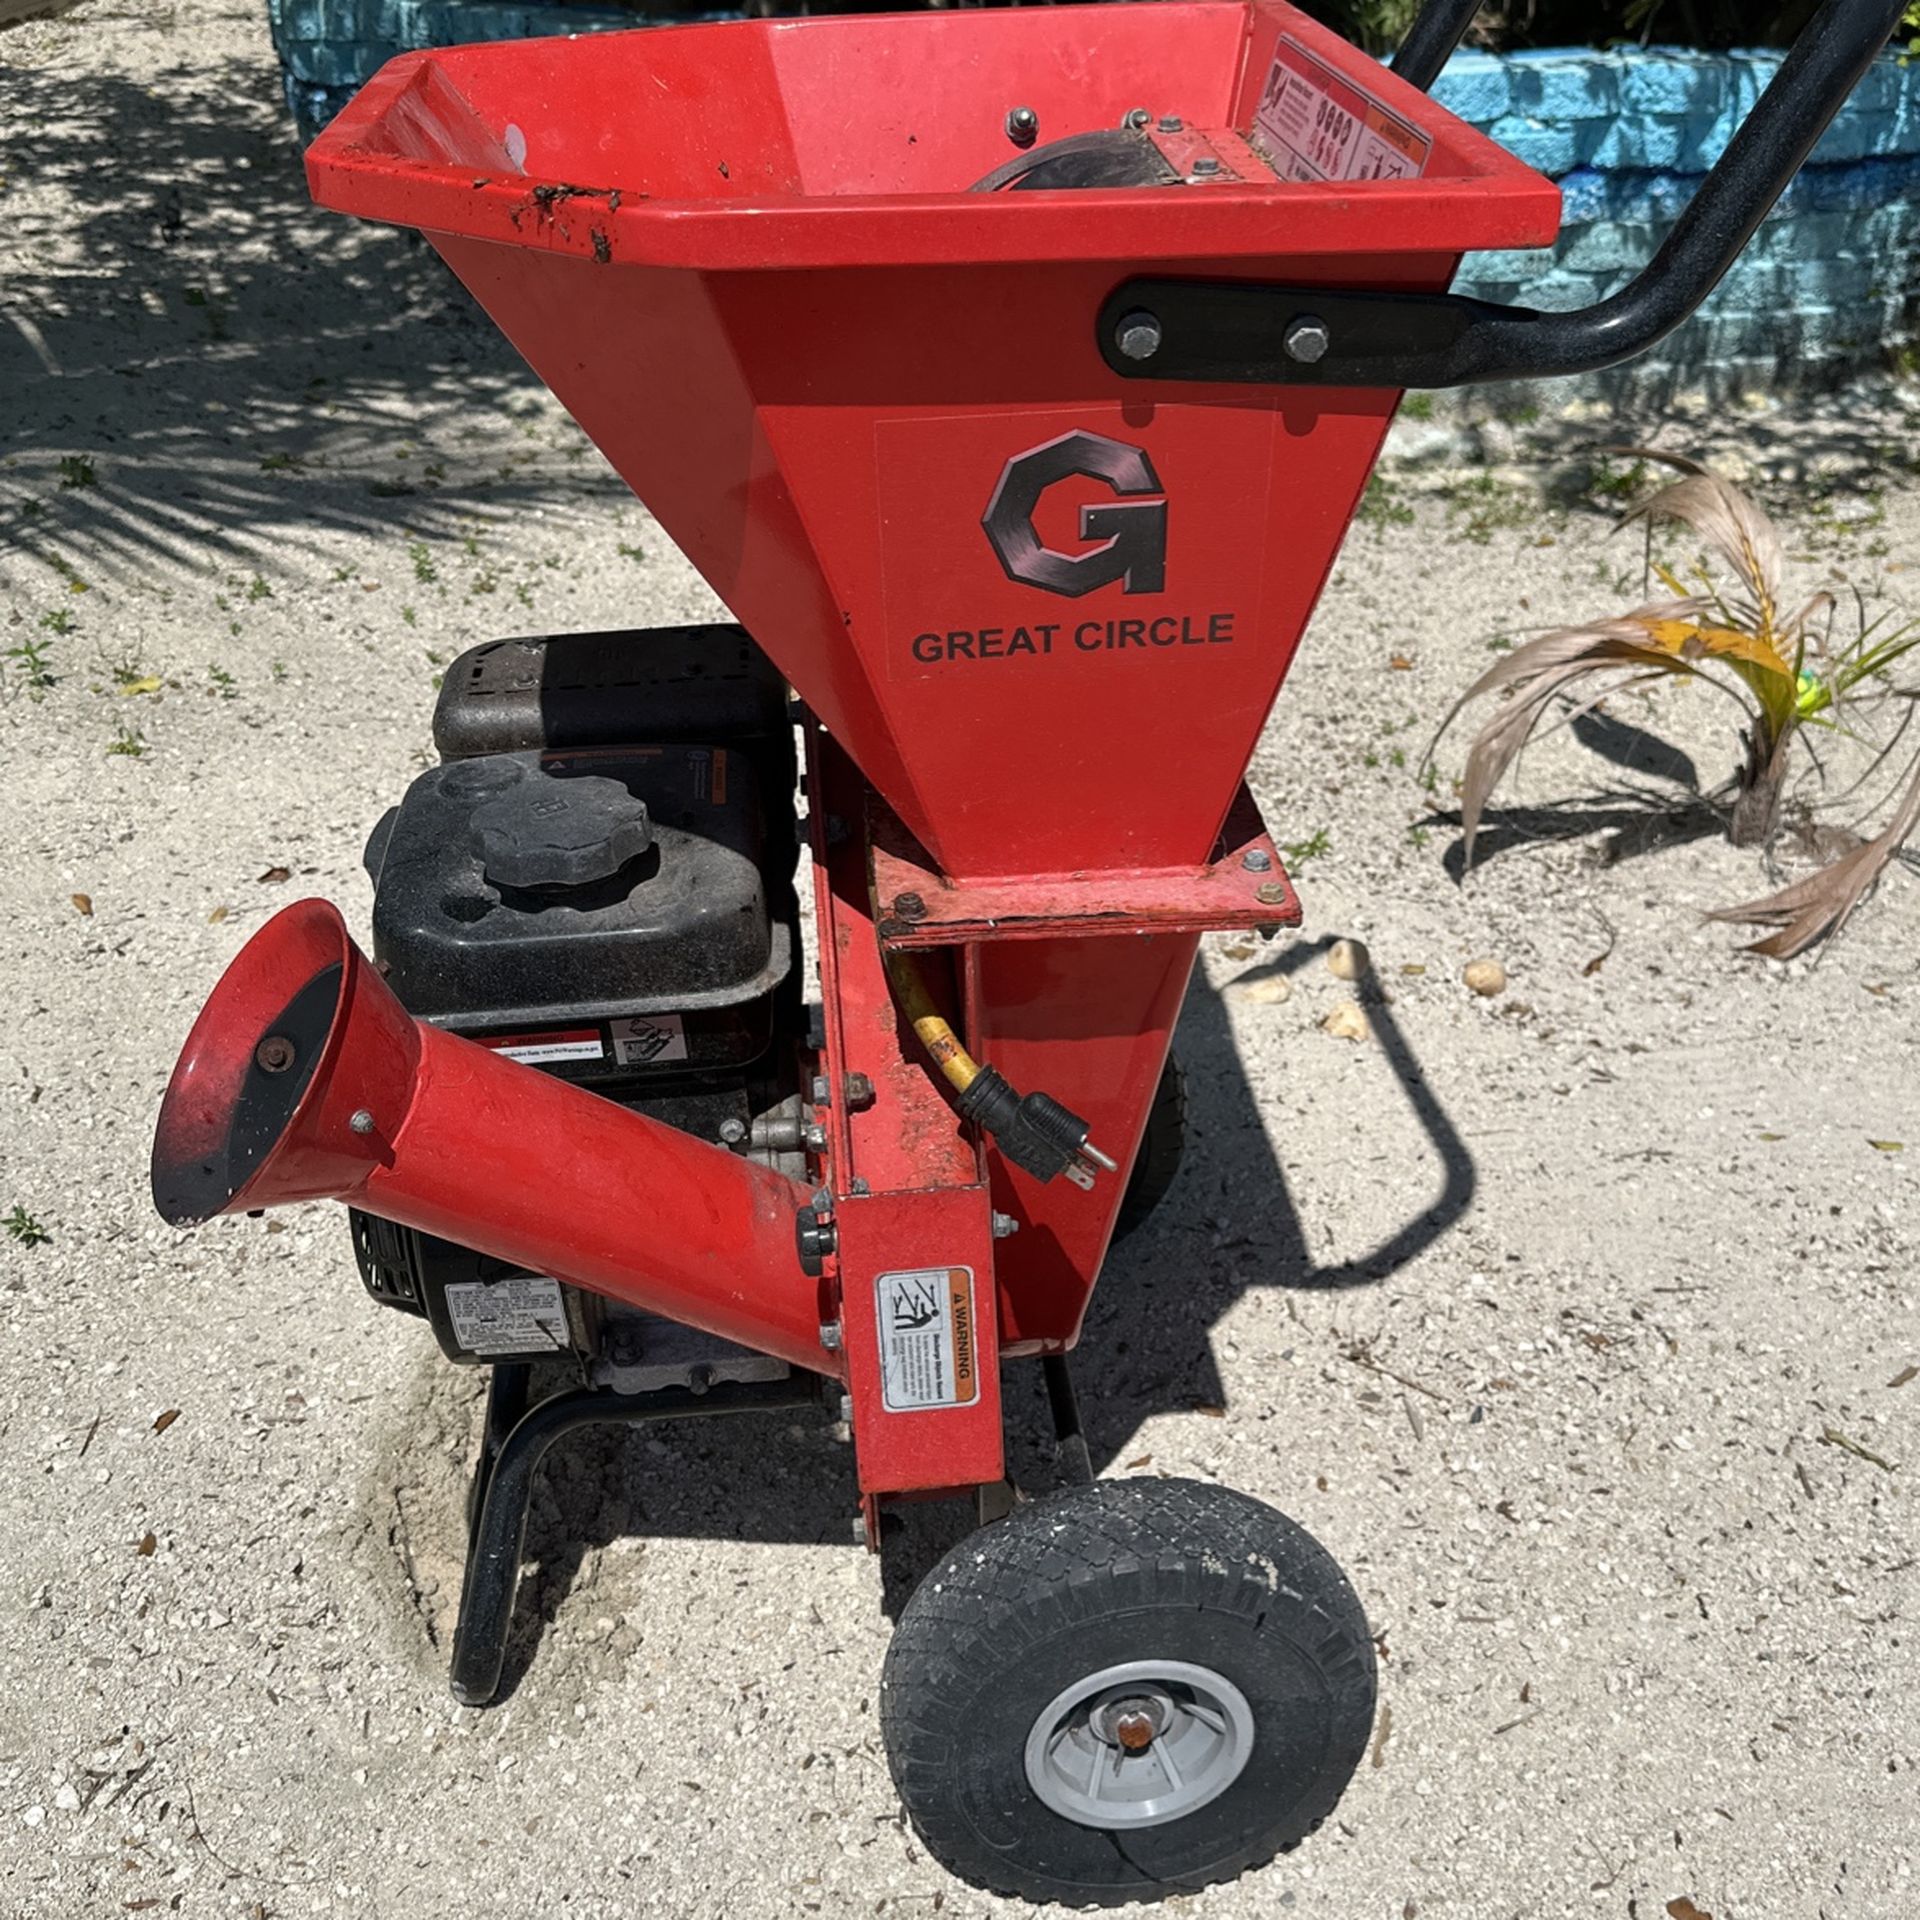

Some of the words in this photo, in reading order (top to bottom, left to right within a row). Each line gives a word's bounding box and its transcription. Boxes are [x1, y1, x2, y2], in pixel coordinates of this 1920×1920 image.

[912, 624, 1061, 663] GREAT
[1074, 613, 1235, 652] CIRCLE
[955, 1306, 970, 1379] WARNING
